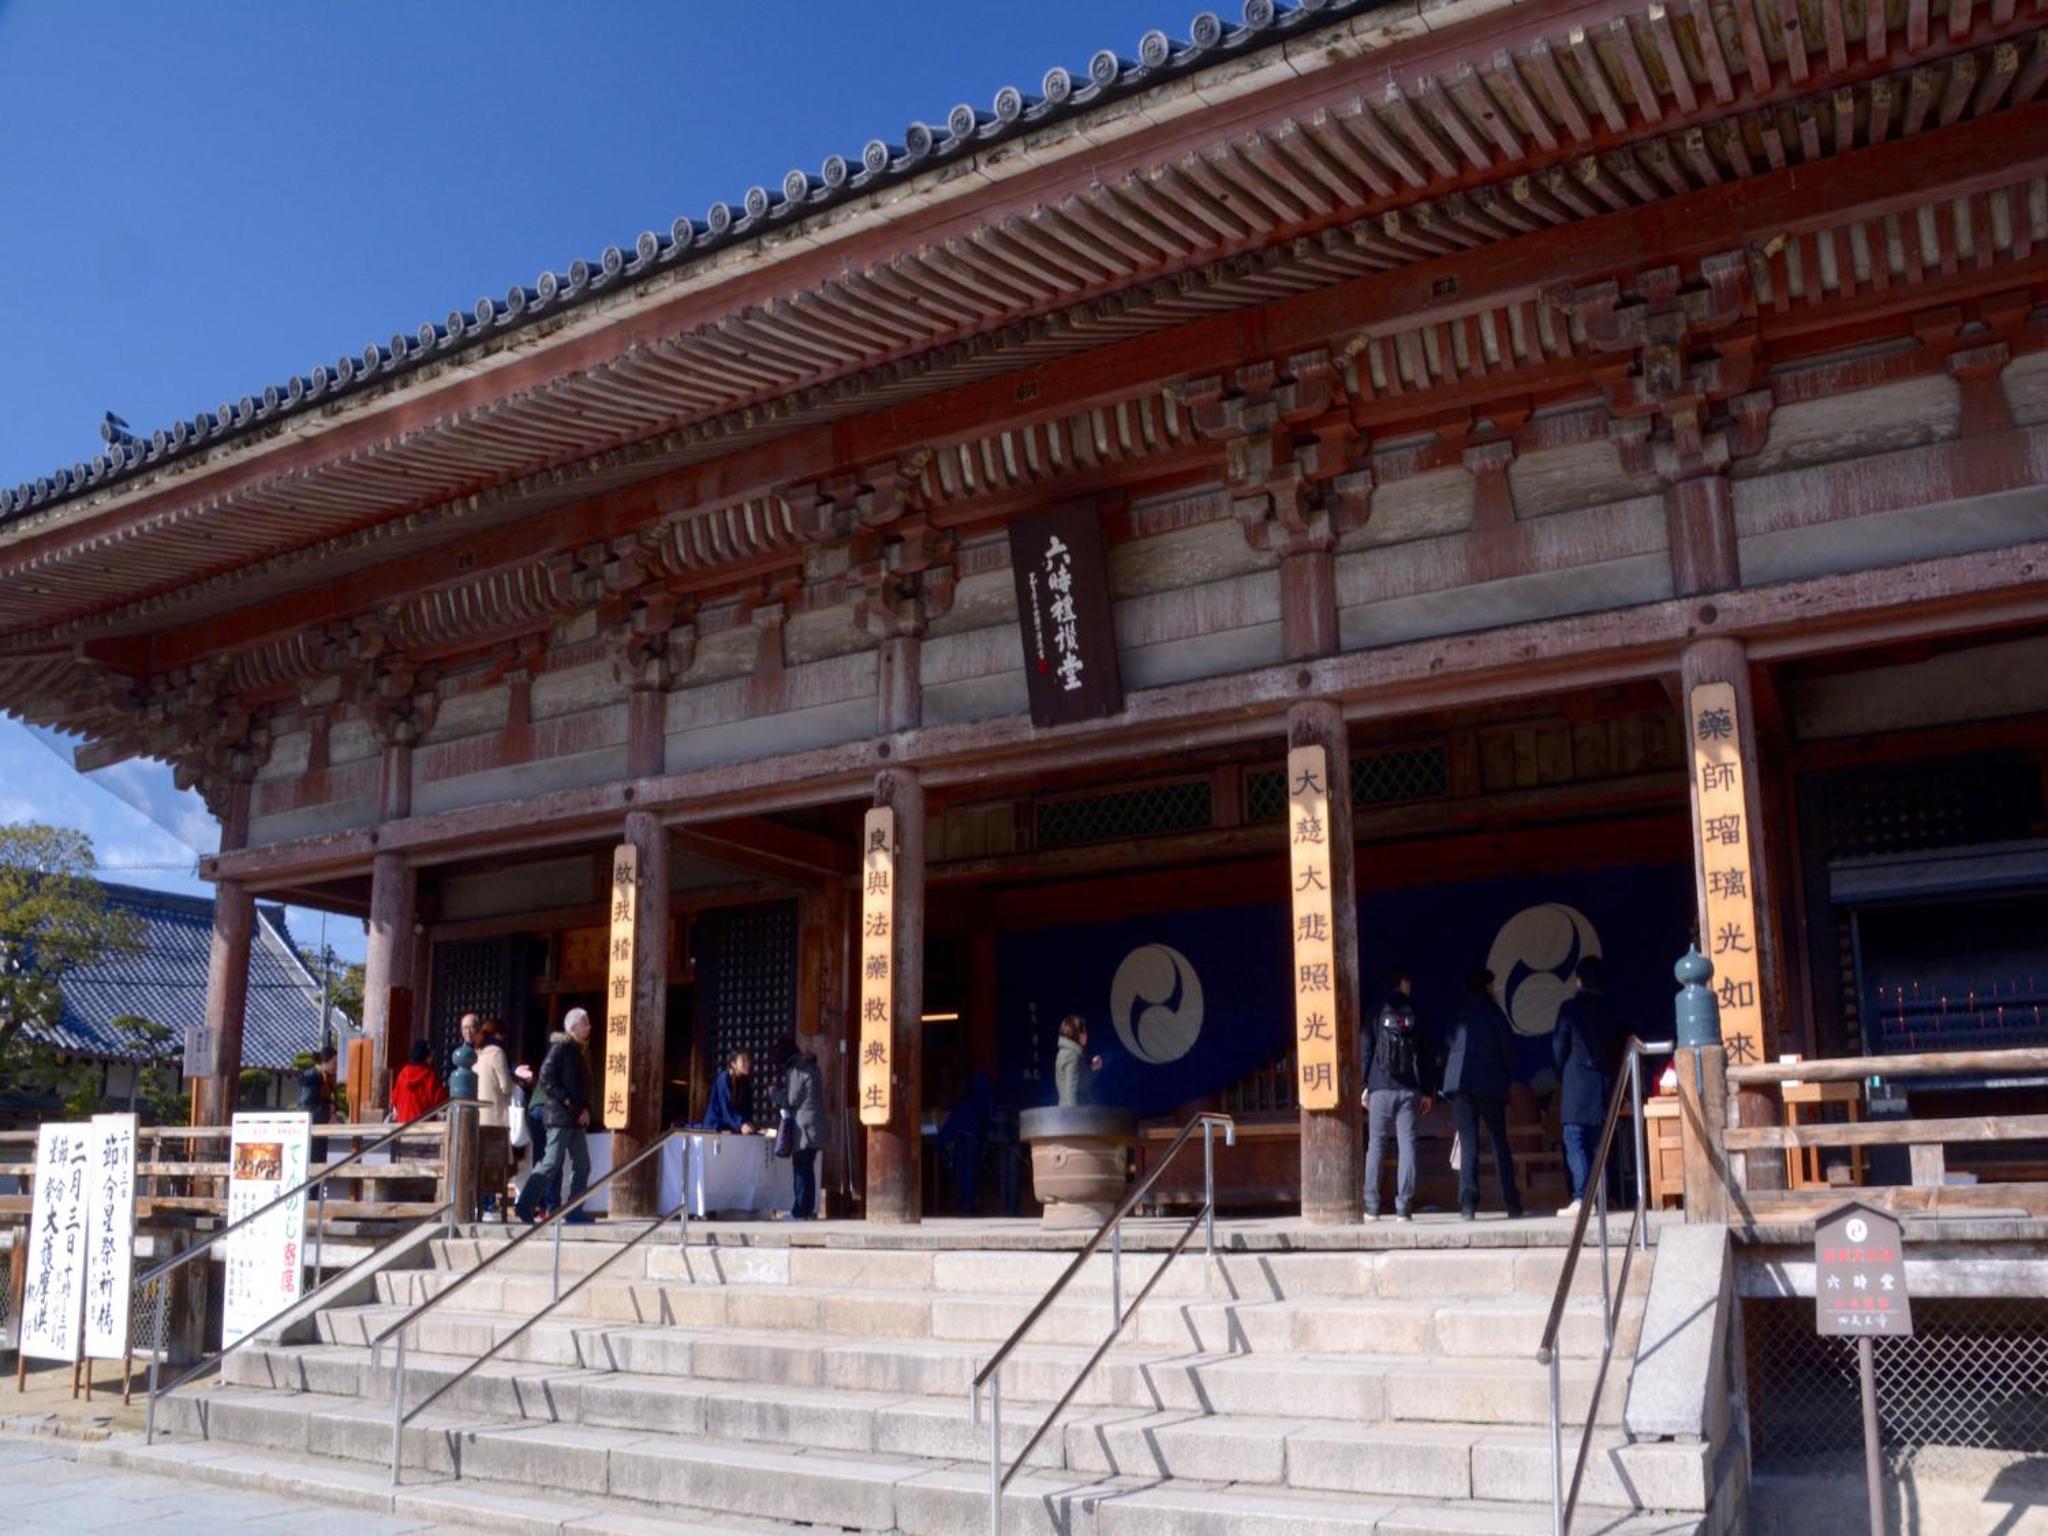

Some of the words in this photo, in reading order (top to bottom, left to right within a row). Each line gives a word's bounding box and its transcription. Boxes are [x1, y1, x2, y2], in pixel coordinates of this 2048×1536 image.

[607, 863, 634, 1115] 故我稽首瑠璃光
[1293, 769, 1332, 1091] 大慈大悲照光明
[65, 1141, 87, 1254] 二月三日
